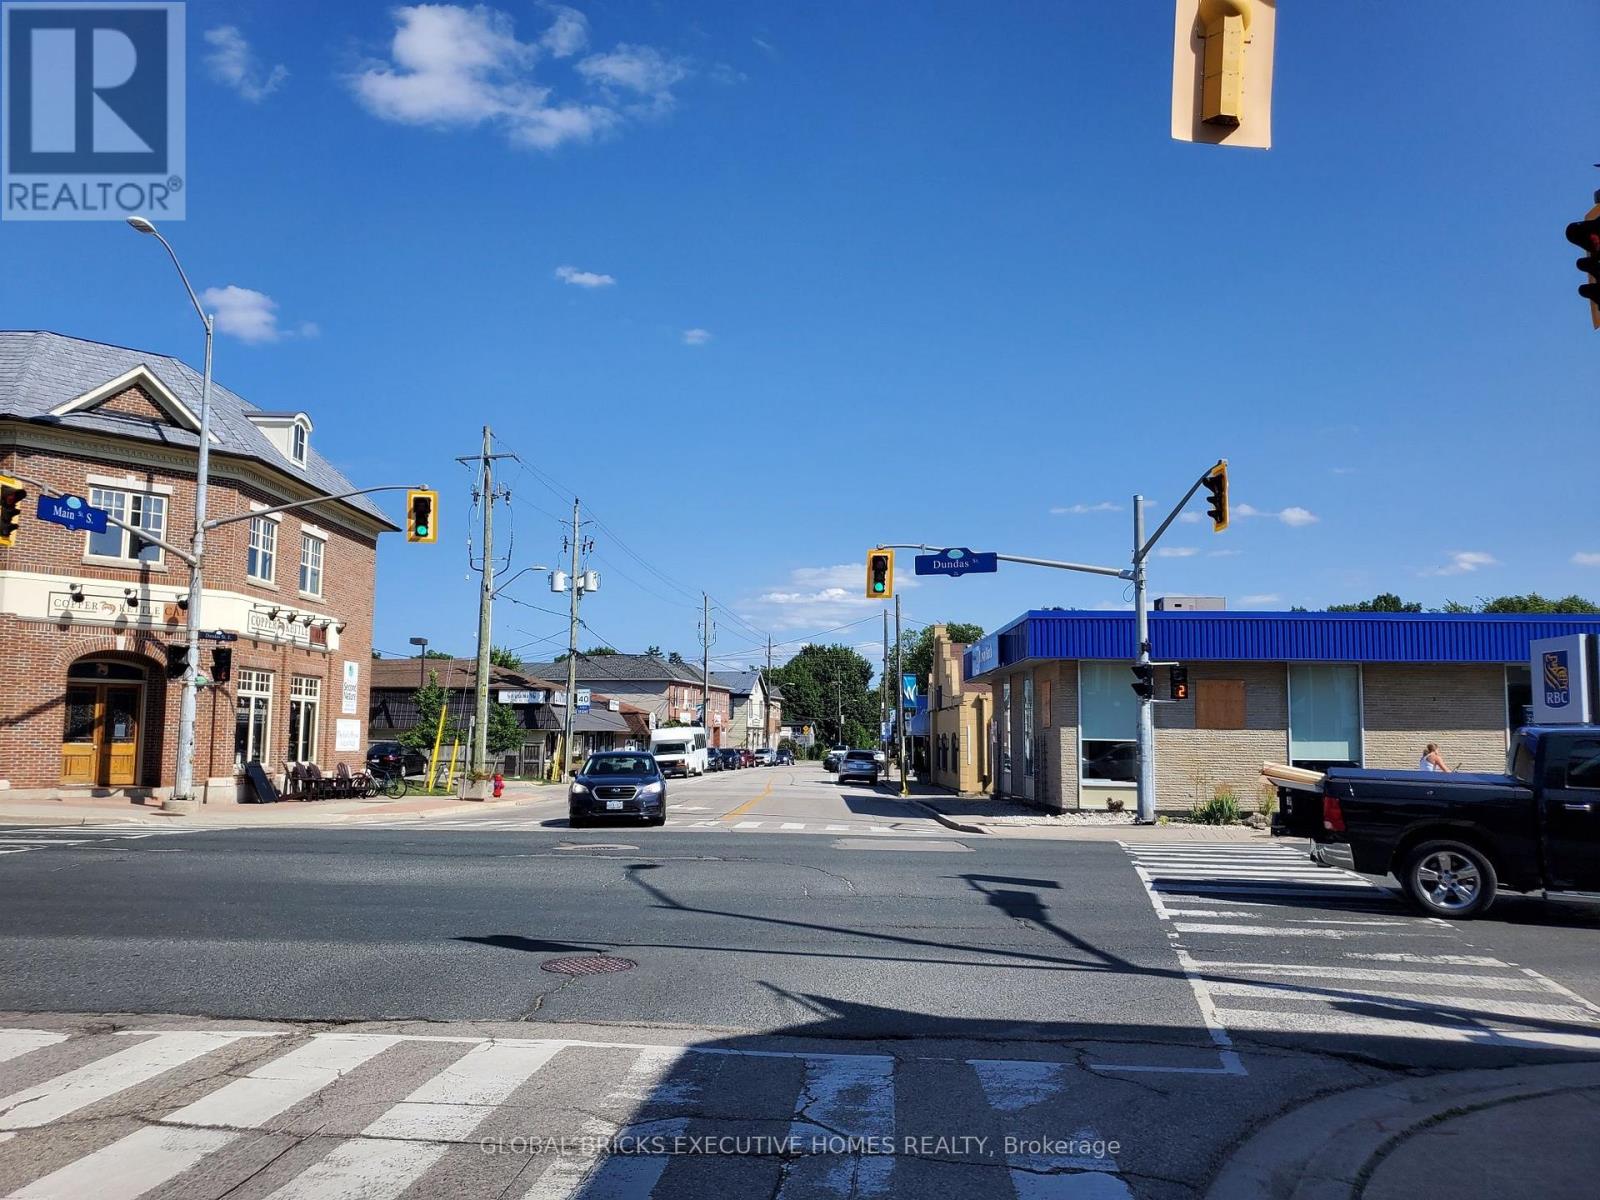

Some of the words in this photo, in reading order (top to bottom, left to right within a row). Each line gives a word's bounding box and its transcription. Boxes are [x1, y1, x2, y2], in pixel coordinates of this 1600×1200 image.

[53, 505, 75, 520] Main
[86, 512, 94, 524] S.
[933, 559, 969, 569] Dundas
[53, 598, 98, 610] COPPER
[119, 603, 161, 615] KETTLE
[251, 614, 278, 630] COPPER
[1178, 684, 1185, 697] 2
[578, 695, 589, 703] 40
[1546, 691, 1568, 704] RBC
